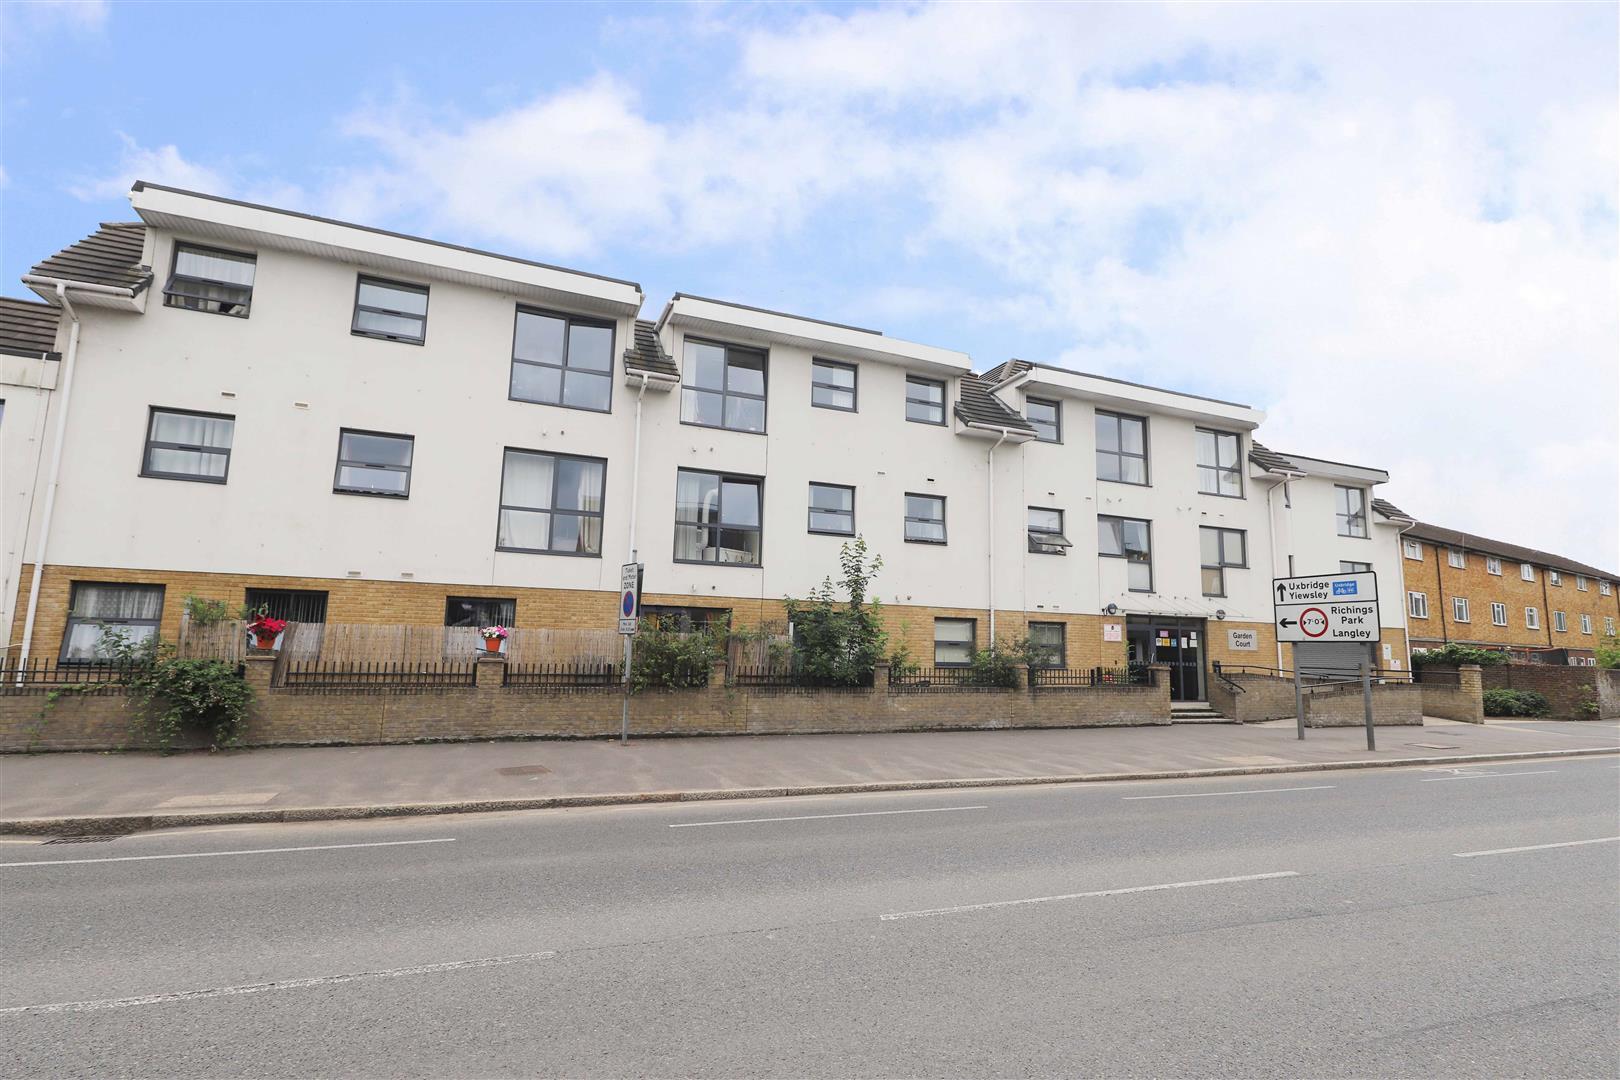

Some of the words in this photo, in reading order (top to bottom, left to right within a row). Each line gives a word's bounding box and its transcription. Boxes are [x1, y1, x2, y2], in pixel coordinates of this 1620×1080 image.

[624, 581, 635, 589] ZONE
[1289, 581, 1329, 590] Uxbridge
[1289, 591, 1328, 600] Yiewsley
[1331, 605, 1374, 615] Richings
[1341, 616, 1364, 625] Park
[1232, 632, 1253, 640] Garden
[1332, 628, 1371, 638] Langley
[1235, 640, 1251, 648] Court
